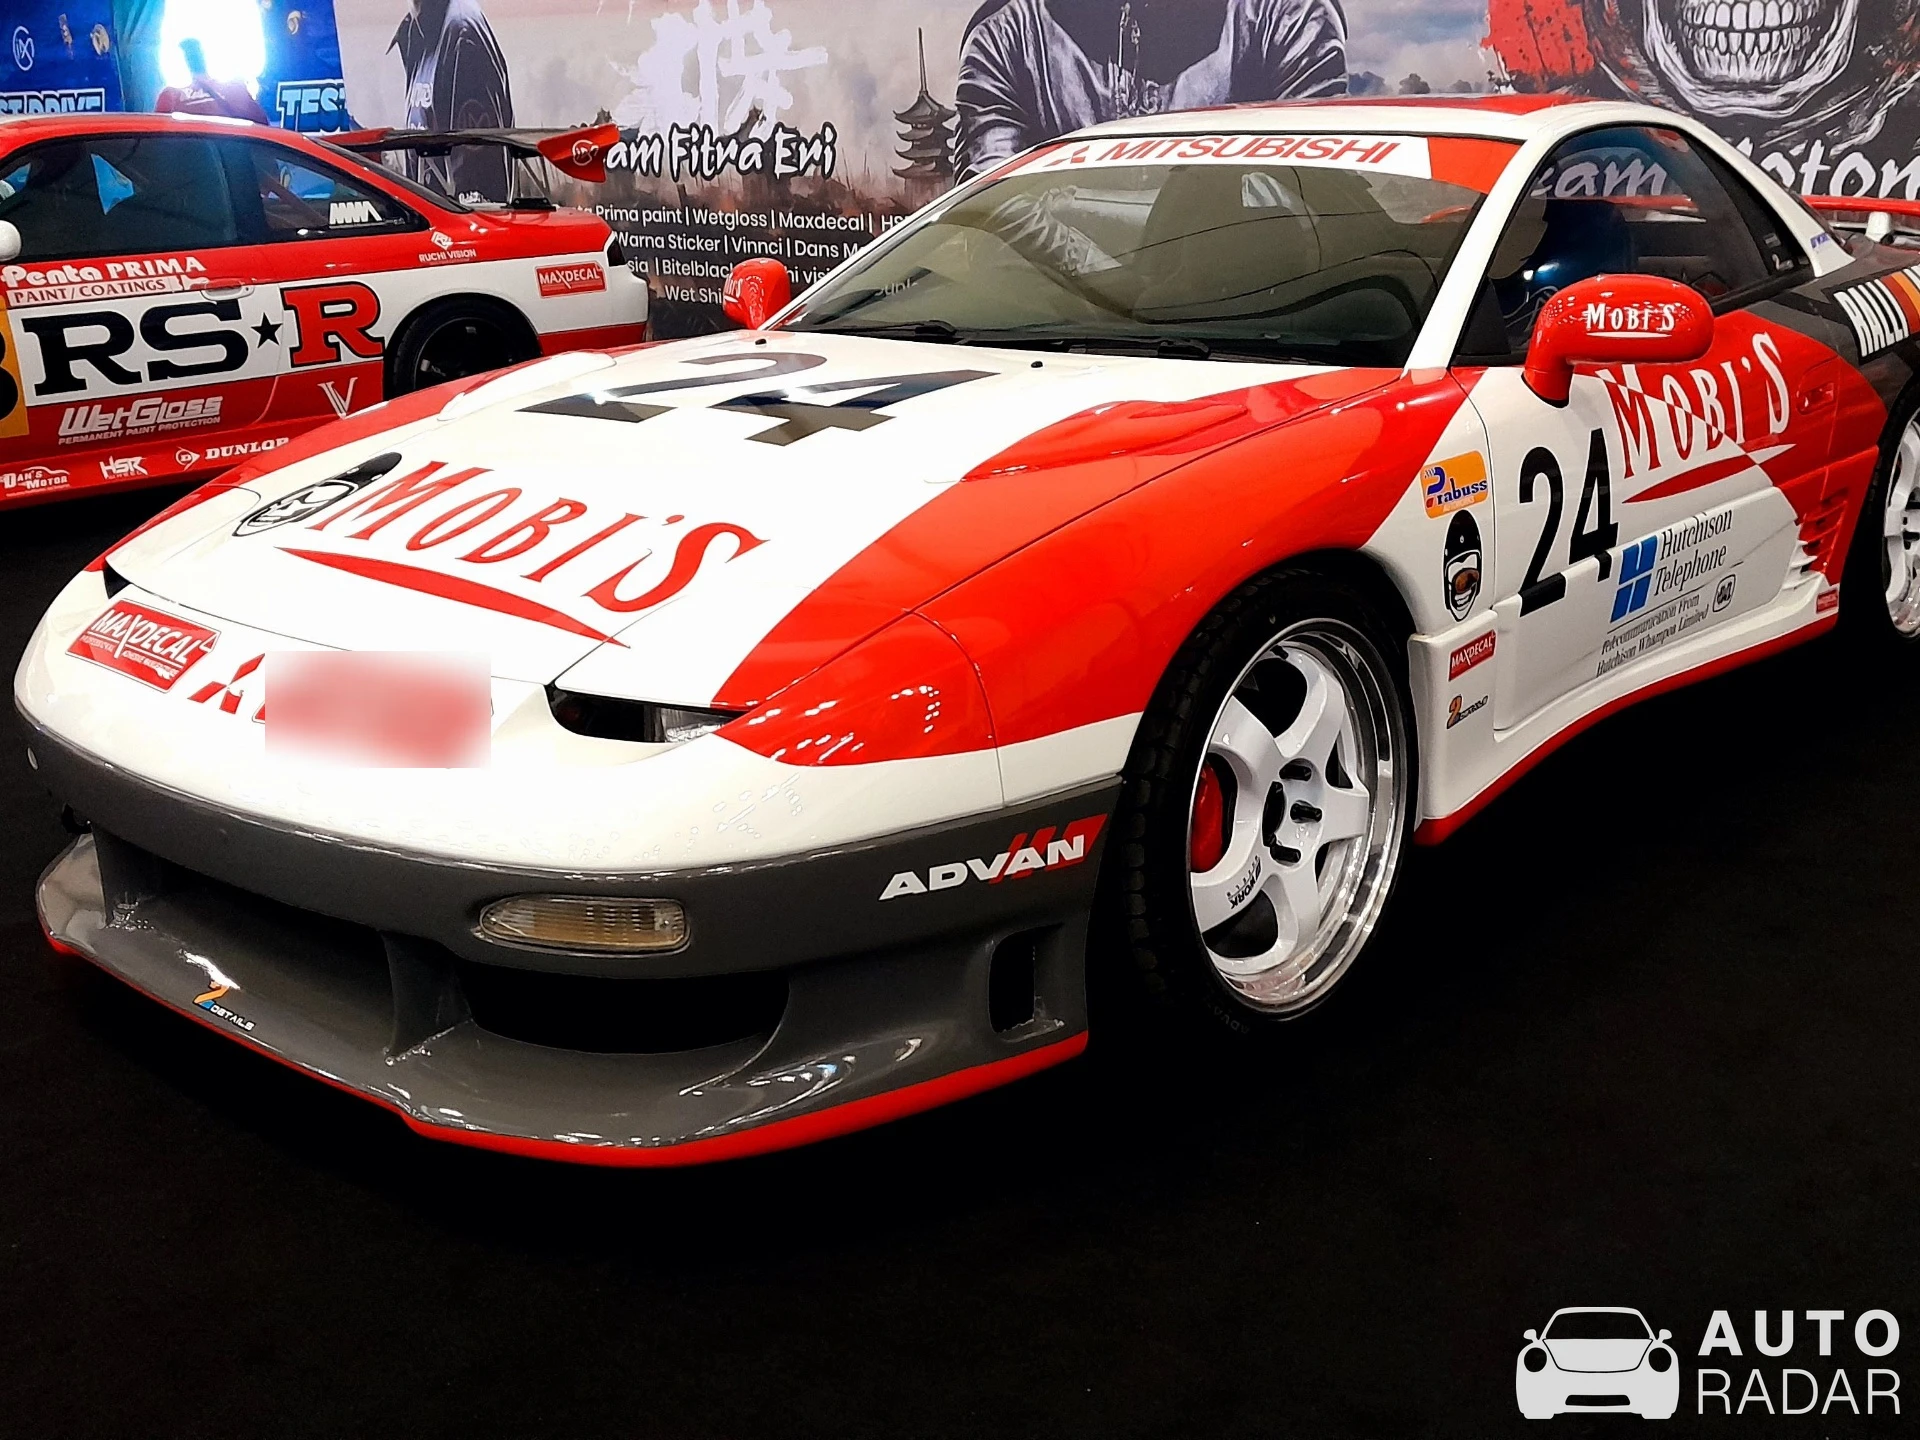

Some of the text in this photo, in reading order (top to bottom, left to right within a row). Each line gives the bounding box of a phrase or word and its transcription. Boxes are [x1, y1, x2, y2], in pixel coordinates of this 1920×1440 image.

[671, 122, 763, 181] Fitra
[773, 124, 836, 180] Eri
[1096, 137, 1400, 163] MITSUBISHI
[596, 205, 638, 222] Prima
[642, 207, 682, 227] paint
[693, 207, 767, 230] Wetgloss
[779, 212, 864, 232] Maxdecal
[419, 252, 447, 263] RUCHI
[448, 249, 476, 260] VISION
[668, 233, 721, 251] Sticker
[731, 237, 782, 255] Vinnci
[795, 240, 839, 258] Dans
[1, 256, 206, 288] Penta PRIMA
[539, 267, 600, 288] MAXDECAL
[665, 285, 696, 301] Wet
[515, 353, 1002, 447] 24
[126, 426, 156, 436] PAINT
[205, 437, 289, 460] DUNLOP
[1518, 428, 1619, 618] 24
[1659, 509, 1732, 561] Hutchison
[1654, 545, 1727, 597] Telephone
[91, 609, 202, 664] MAXDECAL
[1452, 637, 1493, 668] MAXDECAL
[879, 835, 1085, 900] ADVAN
